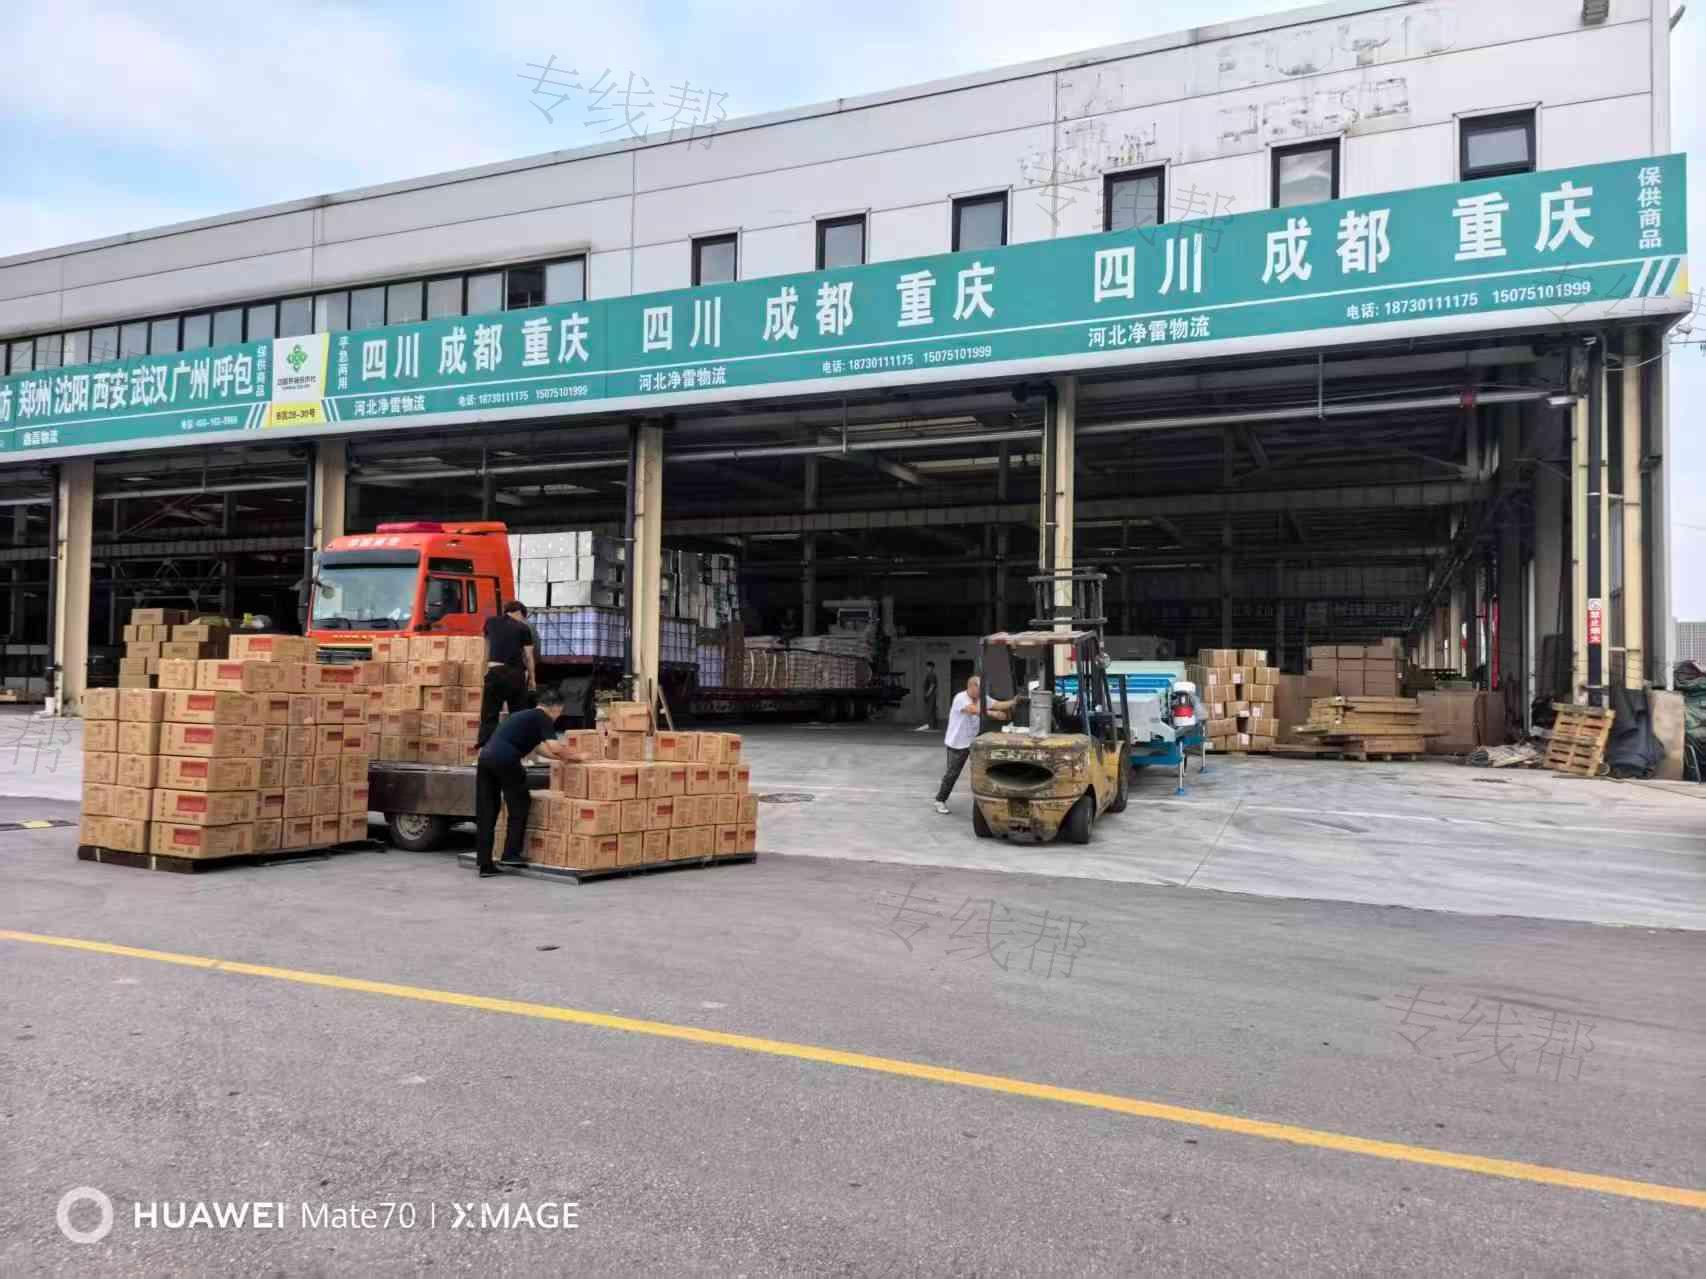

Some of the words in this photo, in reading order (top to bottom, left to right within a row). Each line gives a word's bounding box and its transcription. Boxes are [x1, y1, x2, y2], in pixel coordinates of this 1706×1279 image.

[1637, 166, 1662, 250] 保供商品
[1094, 231, 1203, 302] 四川
[1262, 207, 1390, 284] 成都
[1452, 181, 1595, 262] 重庆
[643, 297, 721, 352] 四川
[763, 281, 853, 341] 成都
[896, 262, 995, 327] 重庆
[1347, 303, 1381, 320] 电话:
[1385, 292, 1479, 316] 18730111175
[1493, 281, 1592, 305] 15075101999
[362, 332, 420, 381] 四川
[438, 324, 502, 375] 成都
[521, 312, 590, 367] 重庆
[1087, 314, 1211, 349] 河北净雷物流
[638, 366, 727, 392] 河北净雷物流
[849, 354, 913, 372] 18730111175
[923, 346, 992, 364] 15075101999
